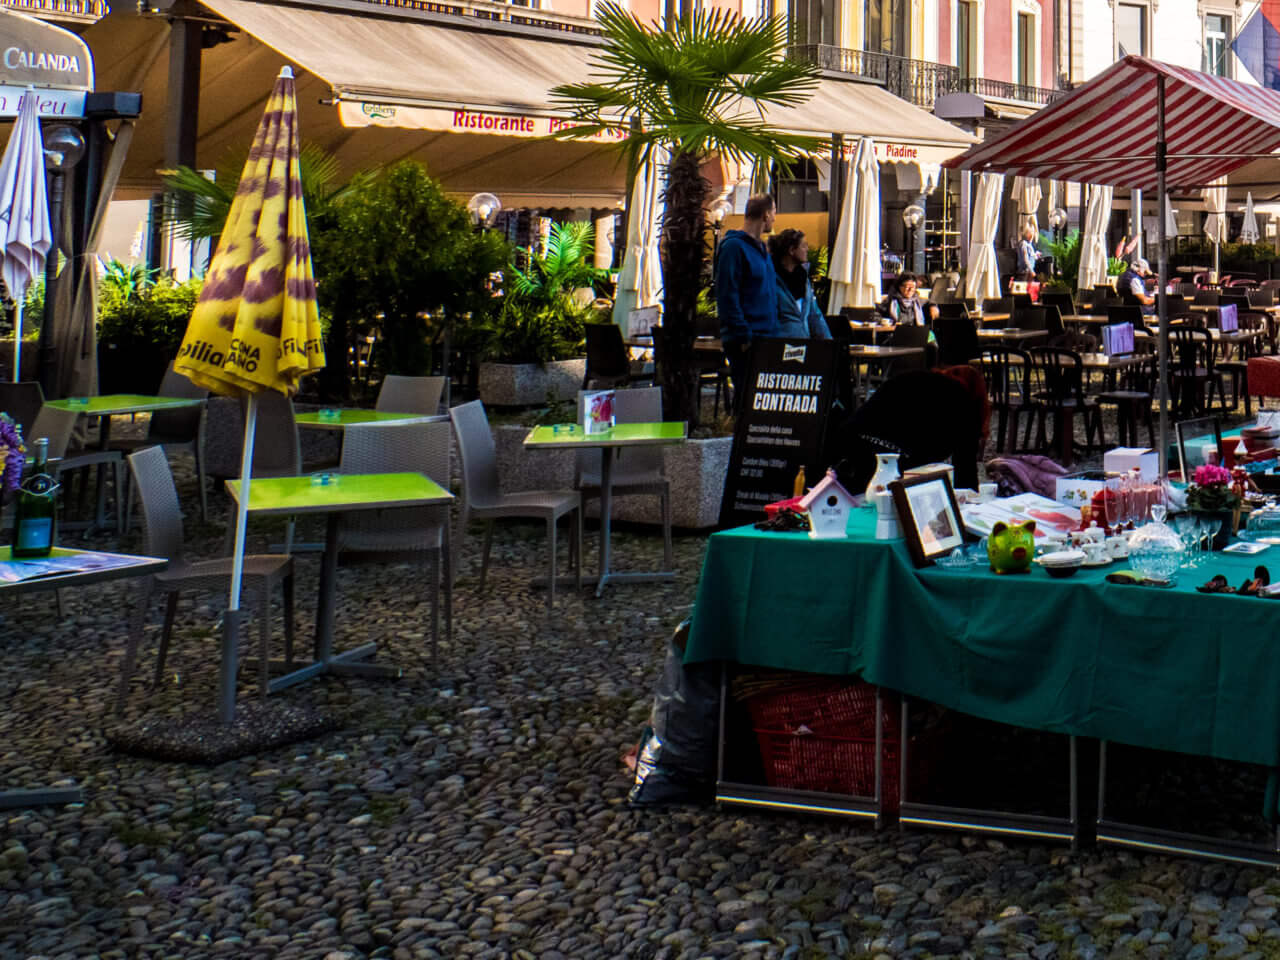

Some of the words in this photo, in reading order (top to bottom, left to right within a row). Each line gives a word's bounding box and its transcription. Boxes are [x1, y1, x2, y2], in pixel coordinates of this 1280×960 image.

[4, 46, 80, 73] CALANDA
[453, 110, 535, 133] Ristorante
[886, 143, 918, 159] Piadine
[757, 372, 822, 392] RISTORANTE
[753, 392, 819, 415] CONTRADA
